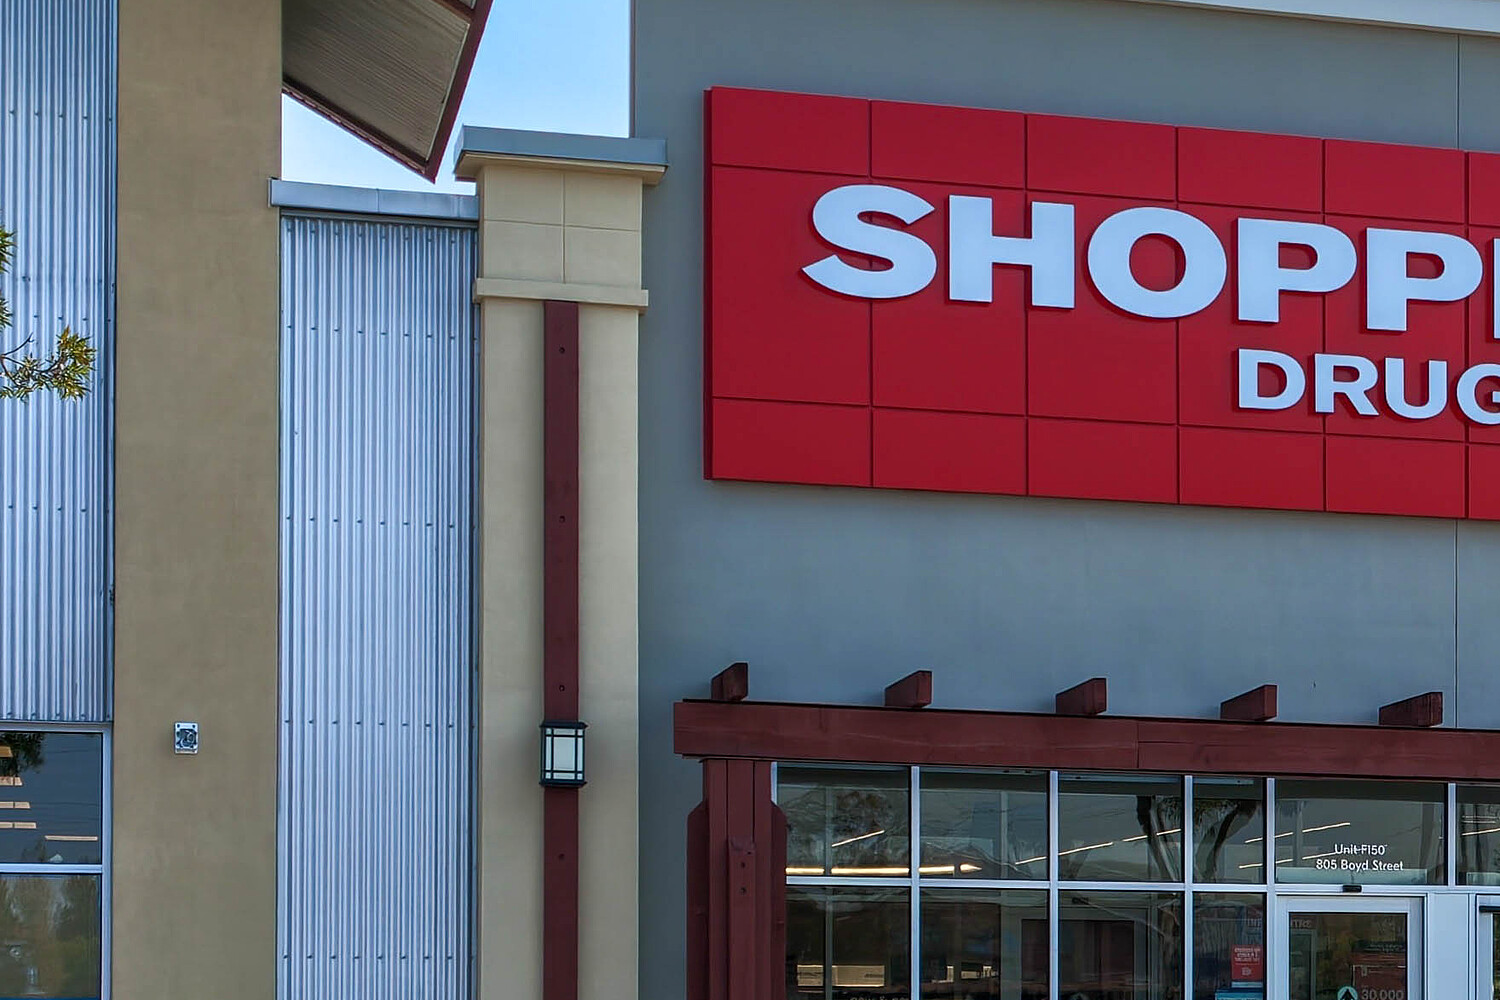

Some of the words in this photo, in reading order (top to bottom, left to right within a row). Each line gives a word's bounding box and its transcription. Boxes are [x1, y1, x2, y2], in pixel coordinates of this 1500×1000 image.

[1334, 843, 1358, 855] Unit
[1316, 859, 1338, 870] 805
[1341, 859, 1369, 872] Boyd
[1372, 860, 1404, 871] Street
